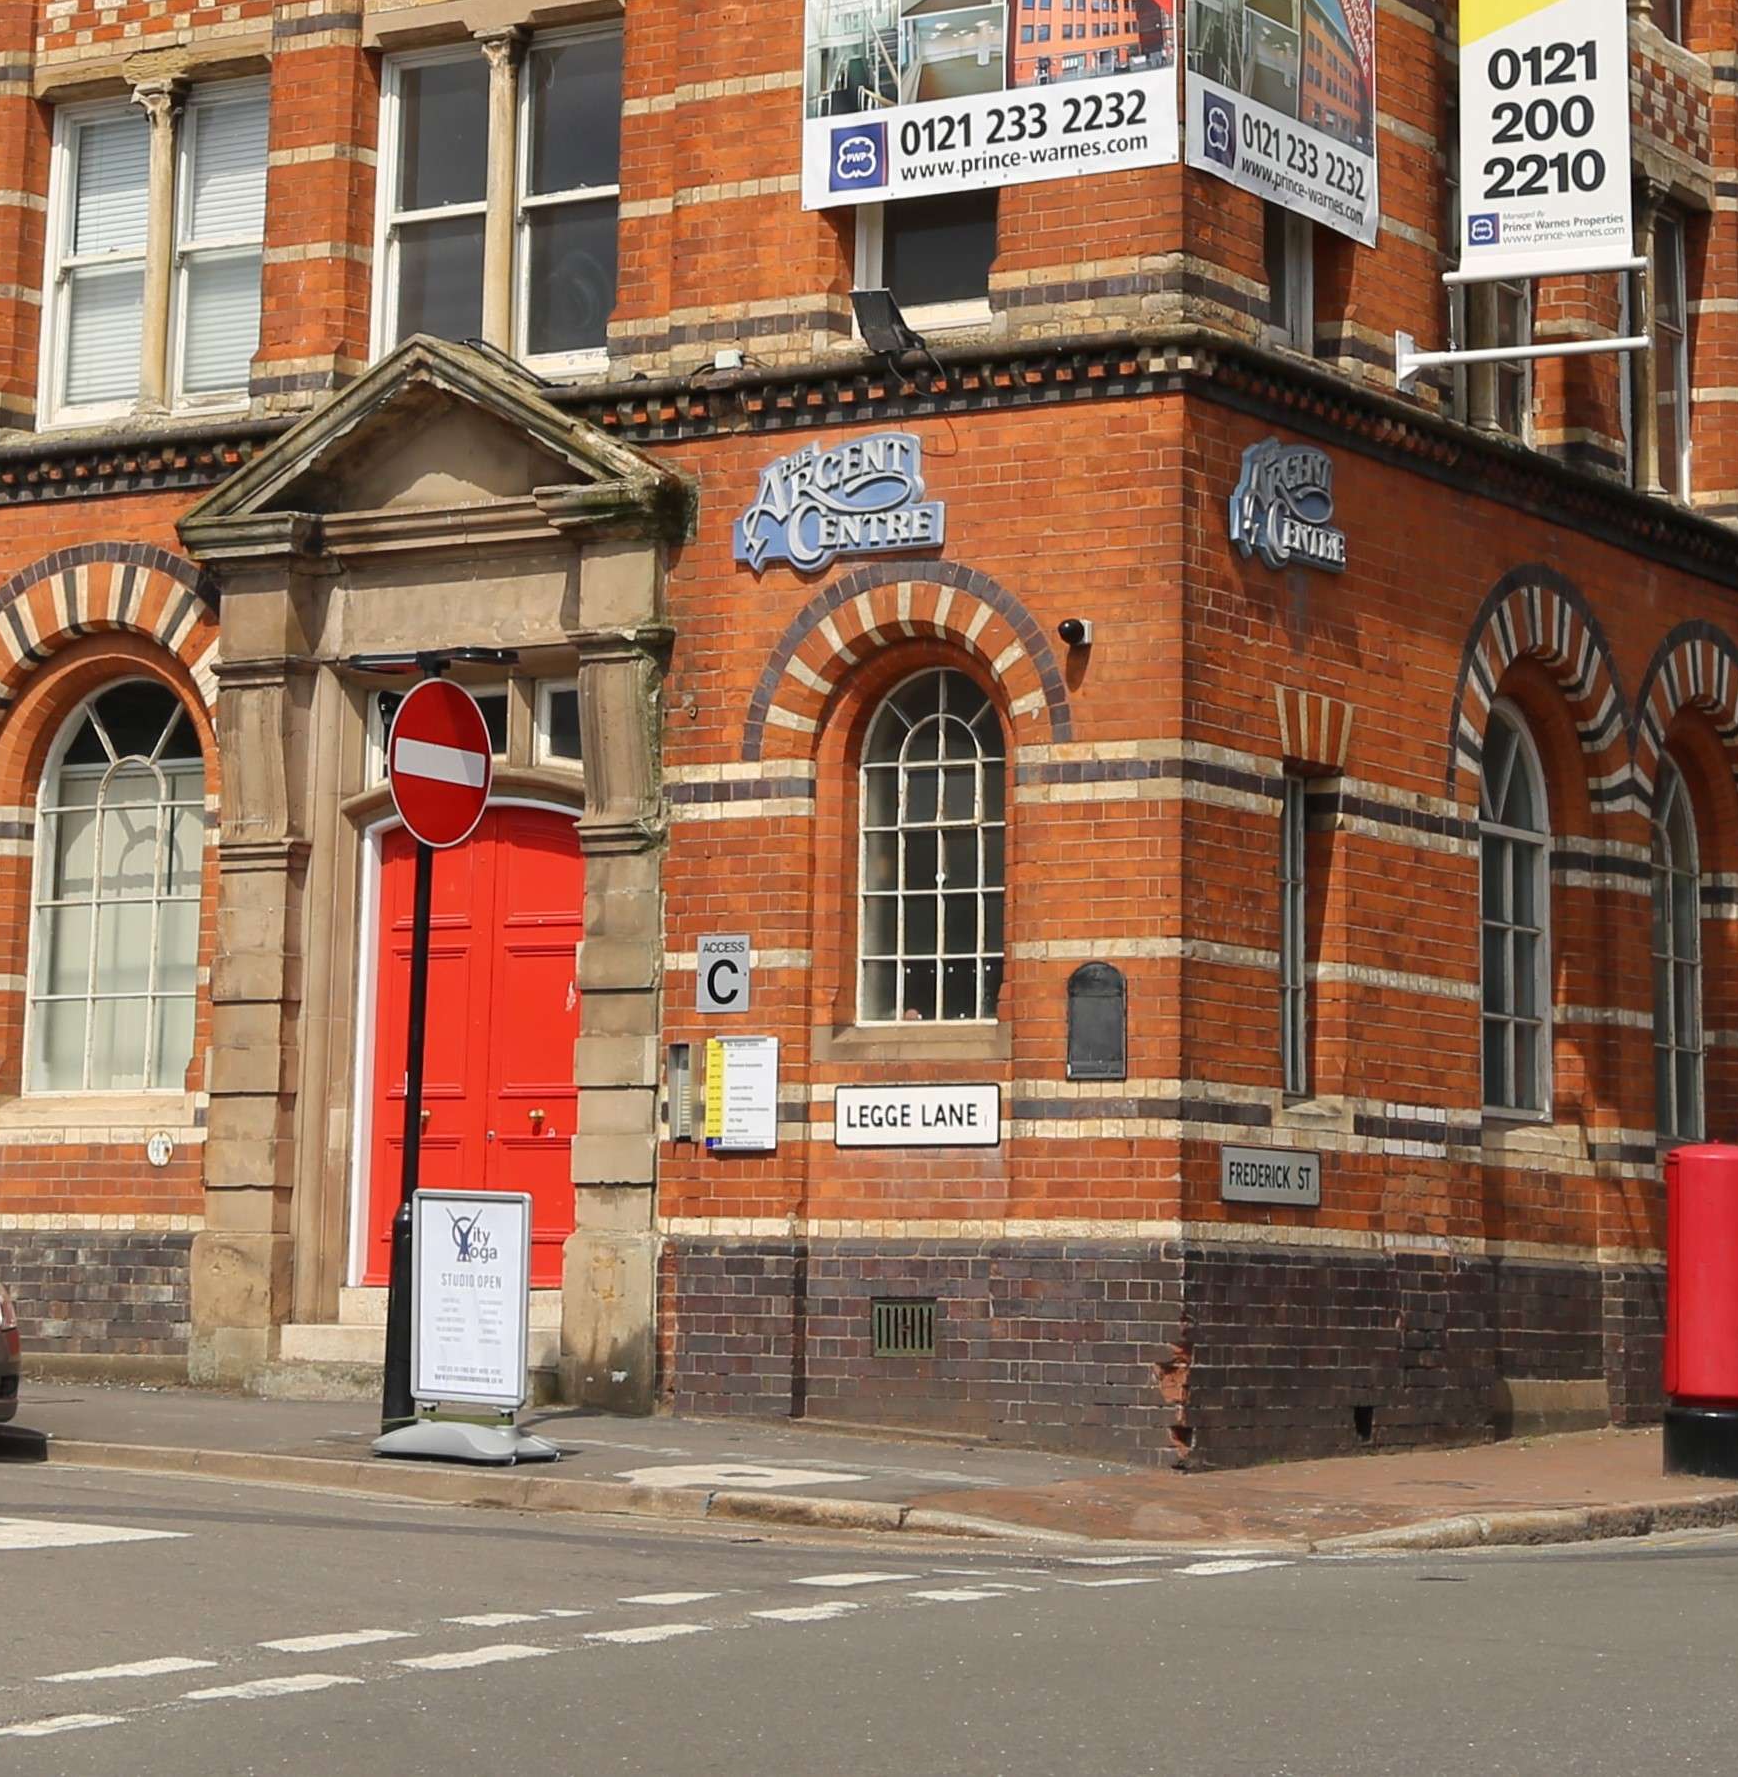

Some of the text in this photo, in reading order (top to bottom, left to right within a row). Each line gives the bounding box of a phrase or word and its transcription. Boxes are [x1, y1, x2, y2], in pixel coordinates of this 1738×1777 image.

[1488, 40, 1597, 90] 0121
[901, 89, 1148, 156] 0121 233 2232
[1492, 95, 1594, 144] 200
[901, 133, 1148, 182] www.prince-warnes.com
[1242, 113, 1365, 201] 0121 233 2232
[1483, 149, 1605, 199] 2210
[1241, 157, 1364, 226] www.prince-warnes.com
[1503, 221, 1532, 233] Prince
[1535, 218, 1570, 230] Warnes
[1573, 214, 1624, 228] Properties
[1503, 225, 1625, 244] www.prince-warnes.com
[782, 449, 812, 479] THE
[743, 438, 911, 540] ARGENT
[788, 501, 933, 562] CENTRE
[703, 941, 745, 954] ACCESS
[707, 959, 739, 1005] C
[847, 1103, 978, 1128] LEGGE LANE
[1229, 1161, 1311, 1190] FREDERICK ST
[441, 1273, 502, 1289] STUDIO OPEN
